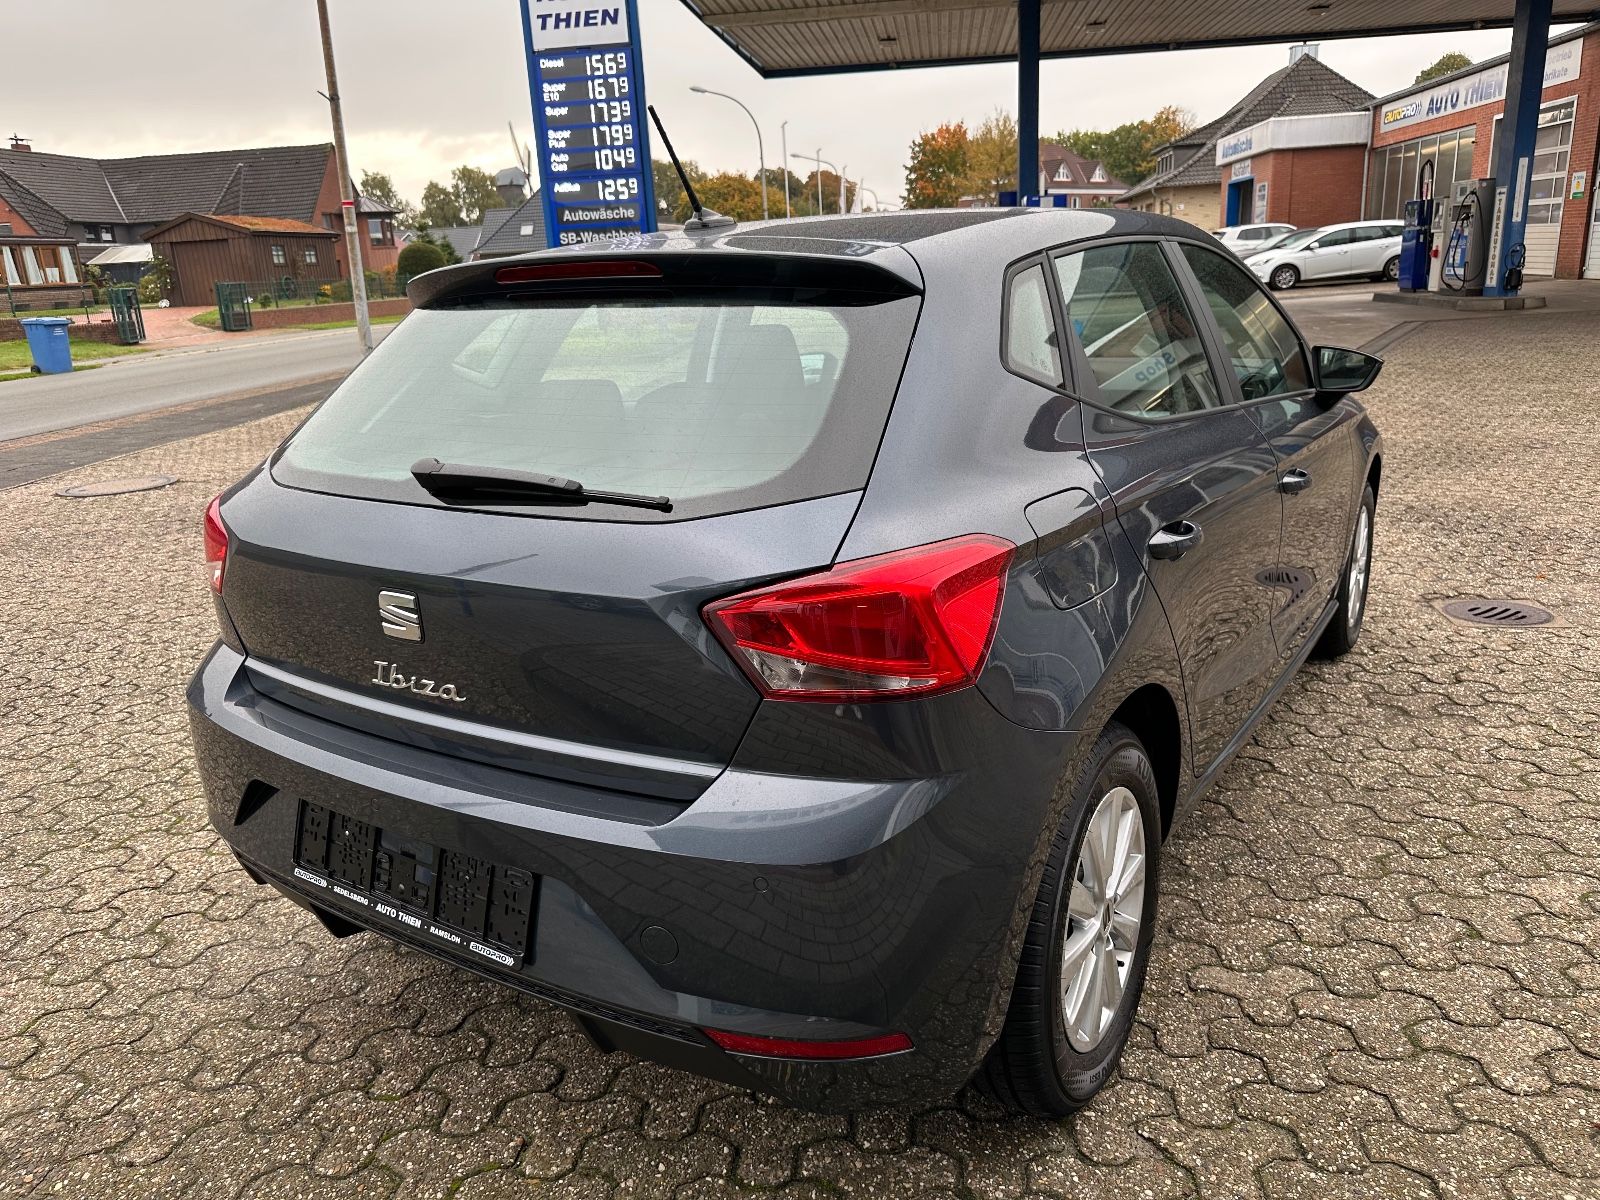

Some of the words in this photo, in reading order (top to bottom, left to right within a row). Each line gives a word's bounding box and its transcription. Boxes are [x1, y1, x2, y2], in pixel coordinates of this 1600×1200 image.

[537, 8, 619, 31] THIEN
[540, 58, 564, 69] Diesel
[585, 52, 627, 76] 1569
[542, 82, 566, 93] Super
[588, 76, 629, 100] 1679
[543, 92, 560, 102] E10
[1426, 91, 1460, 117] AUTO
[1464, 73, 1506, 106] THIEN
[545, 105, 569, 117] Super
[590, 100, 631, 123] 1739
[547, 129, 571, 140] Super
[592, 124, 633, 147] 1799
[548, 139, 566, 148] Plus
[551, 153, 569, 162] Auto
[594, 147, 635, 170] 1049
[551, 162, 568, 172] Gas
[597, 178, 638, 200] 1259
[563, 207, 636, 221] Autowäsche
[372, 660, 467, 701] Ibiza
[333, 885, 369, 906] SEDELSBERG
[375, 903, 397, 918] AUTO
[398, 911, 422, 929] THIEN
[429, 926, 461, 944] RAMSLOH
